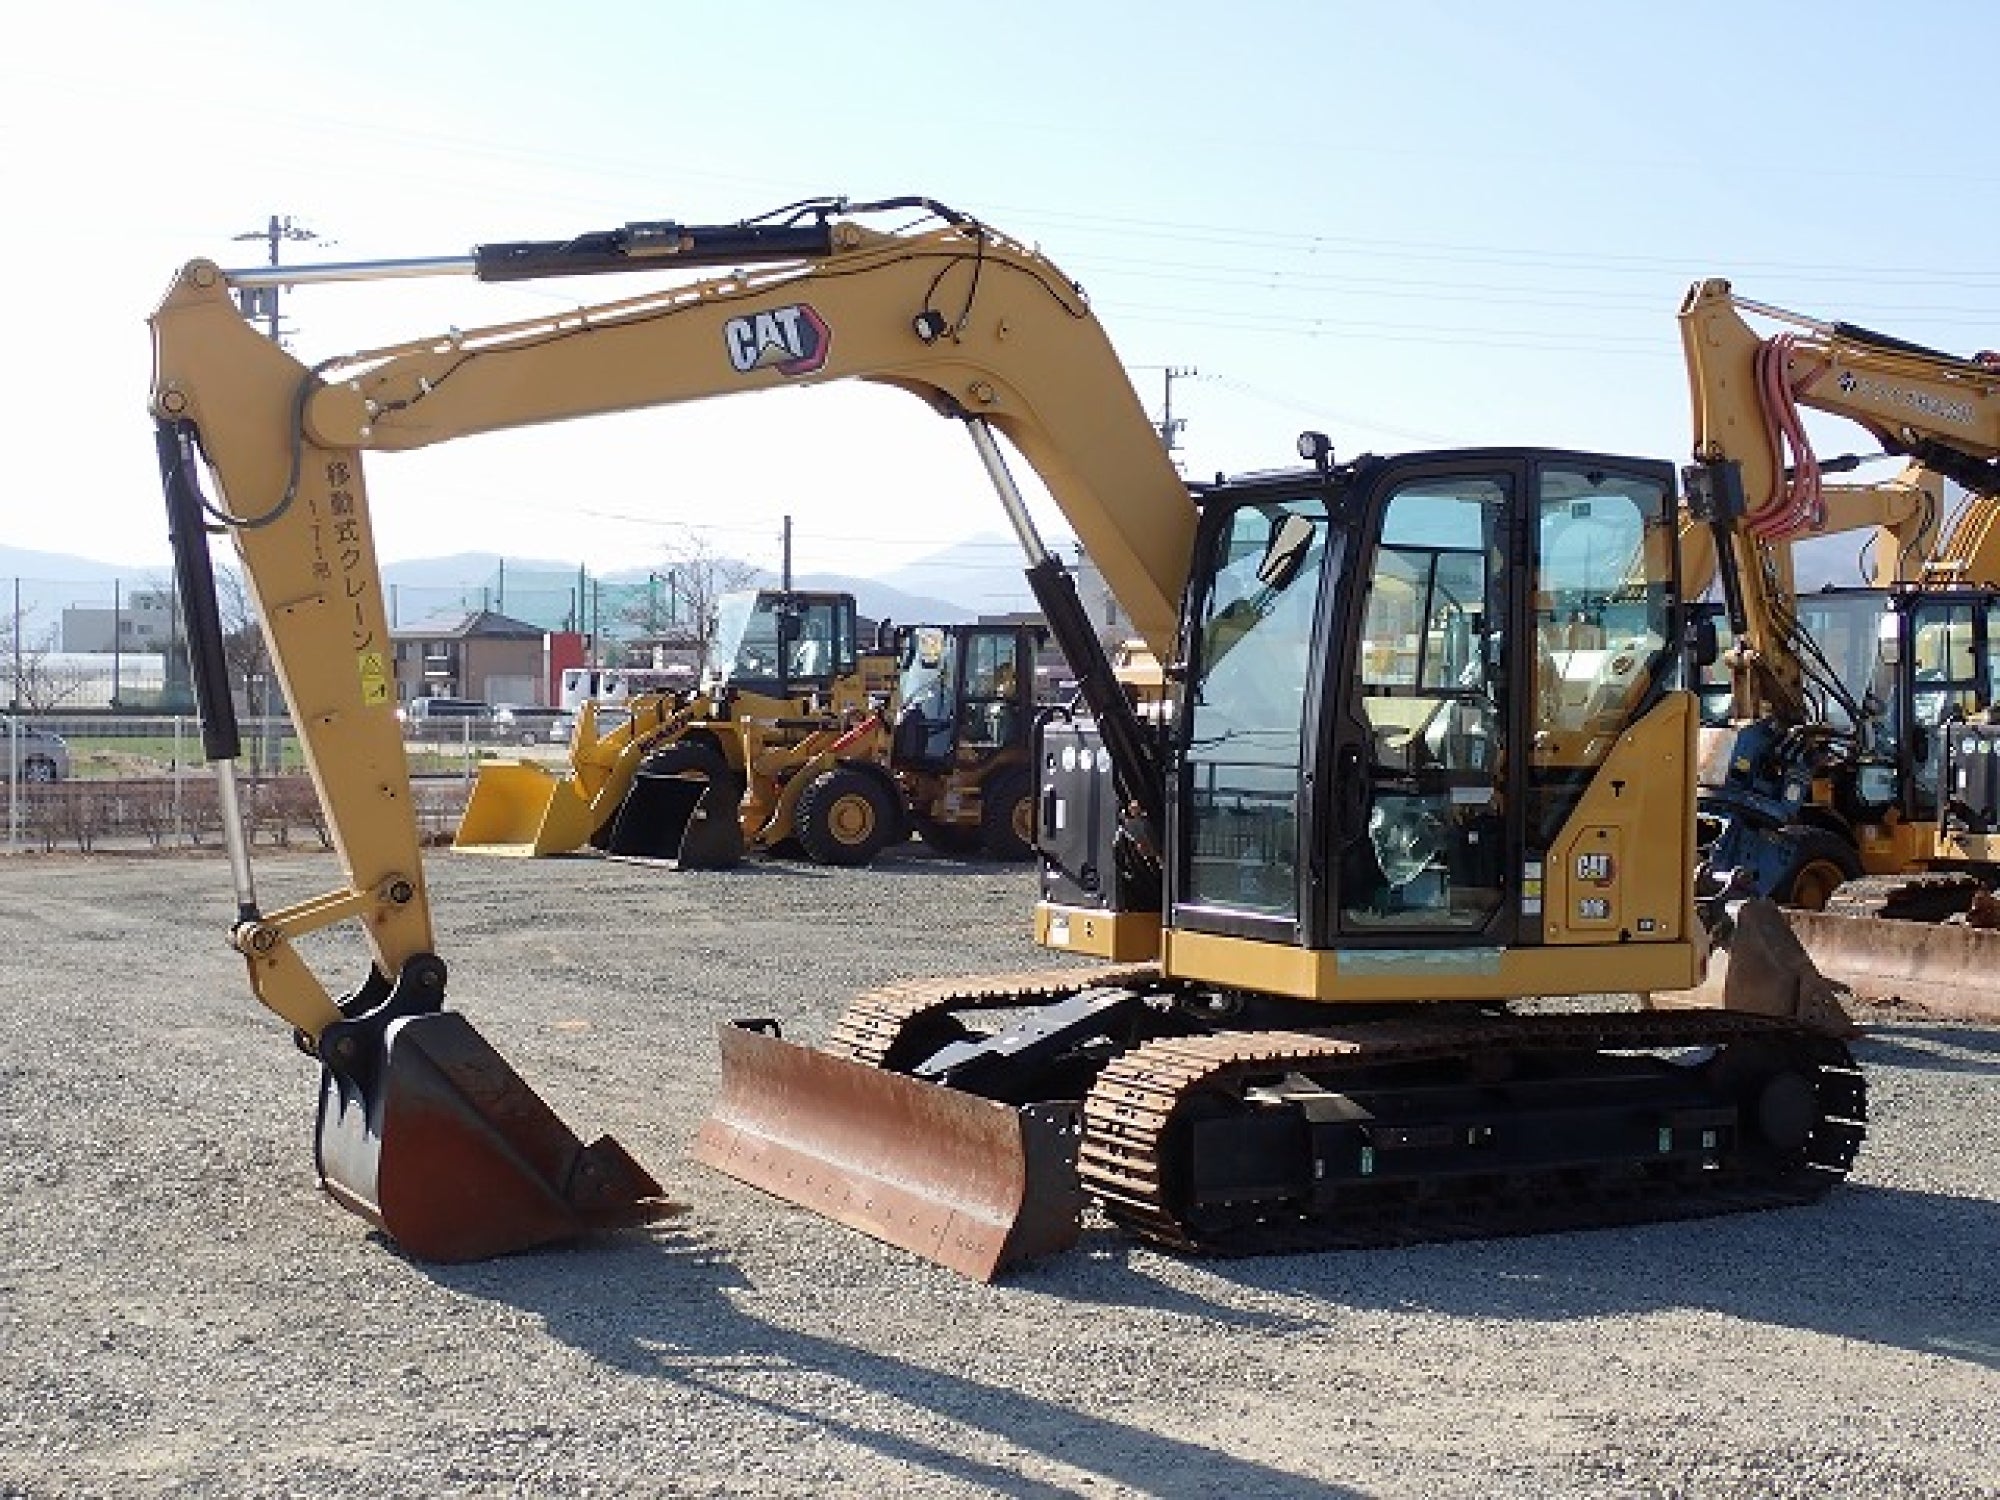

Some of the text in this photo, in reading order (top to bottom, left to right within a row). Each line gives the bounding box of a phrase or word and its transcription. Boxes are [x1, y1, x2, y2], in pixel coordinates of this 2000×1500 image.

[726, 306, 804, 370] CAT
[326, 461, 373, 652] 移動式クレーン
[1577, 855, 1610, 879] CAT
